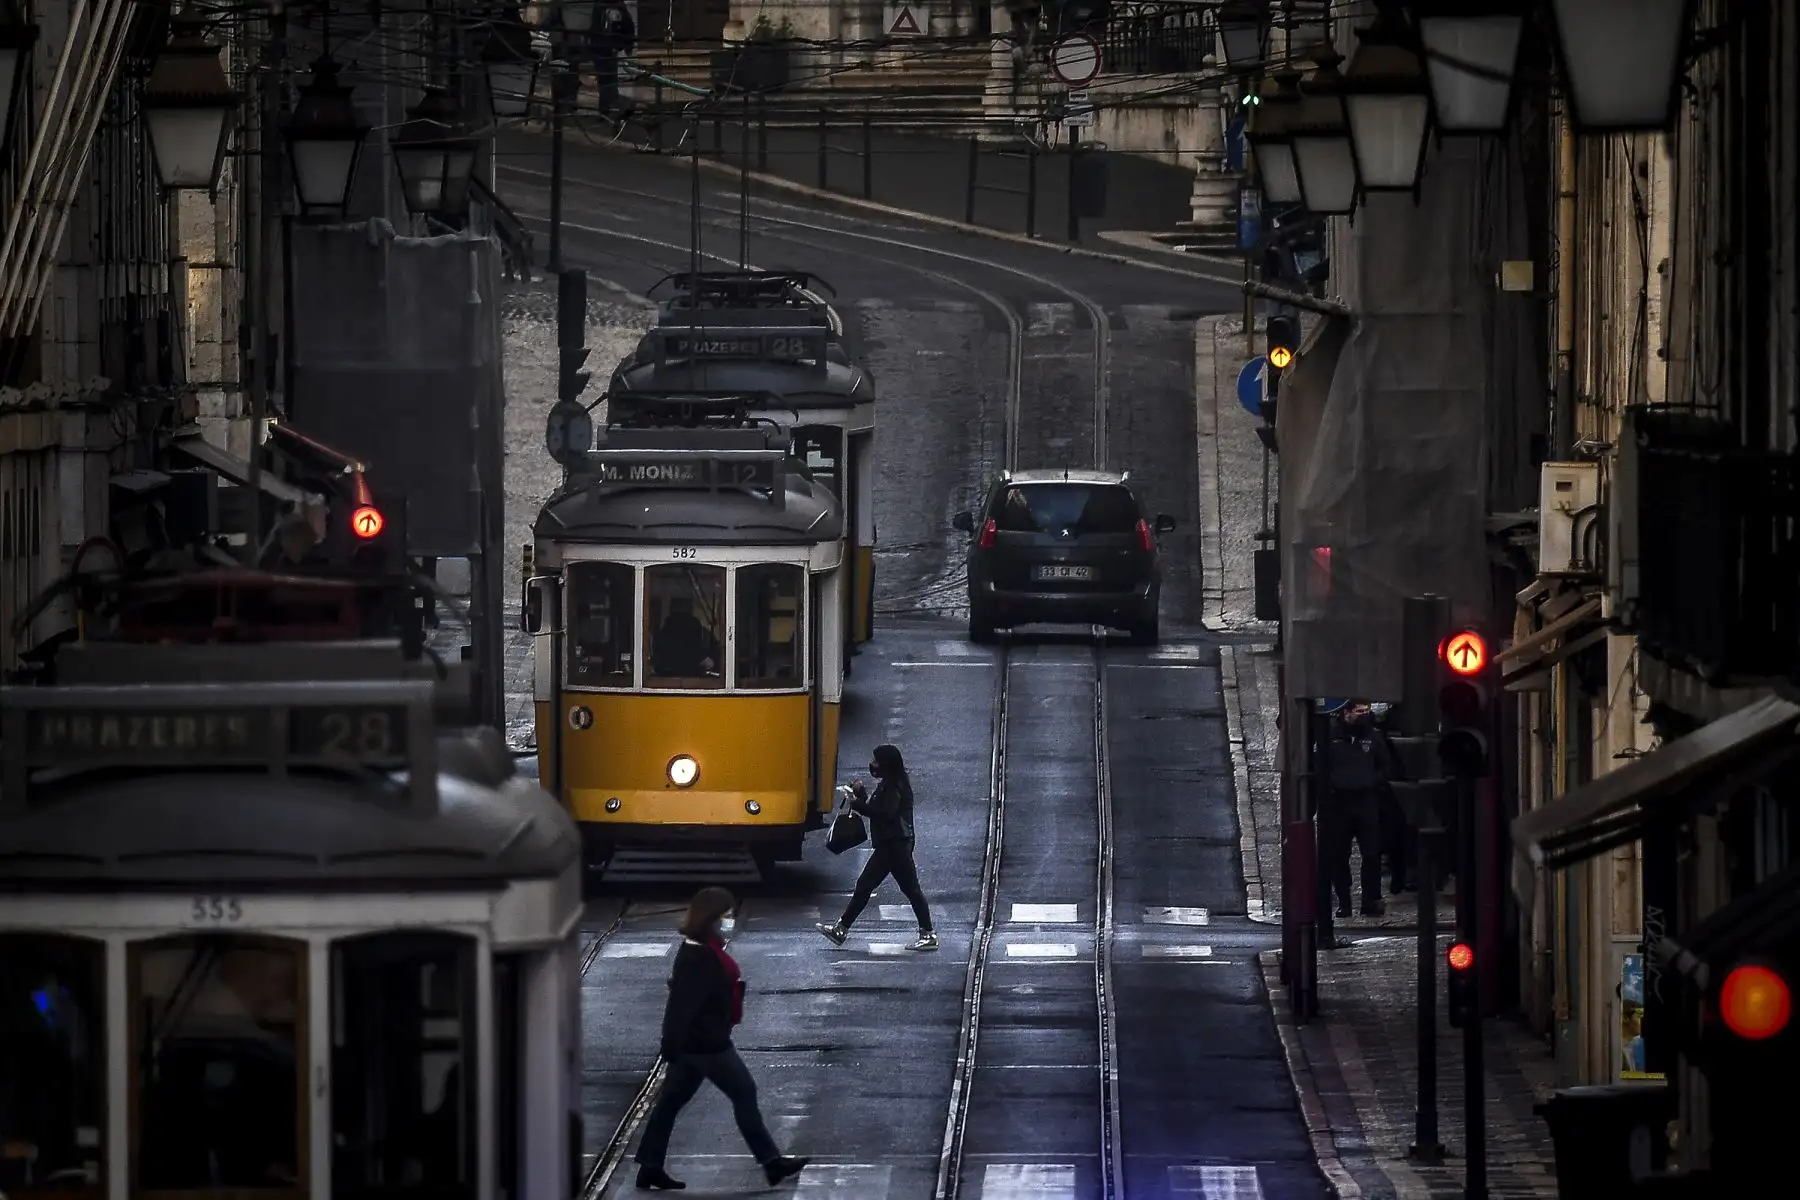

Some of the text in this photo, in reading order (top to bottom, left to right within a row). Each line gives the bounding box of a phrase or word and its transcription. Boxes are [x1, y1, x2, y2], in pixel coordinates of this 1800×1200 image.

[773, 338, 804, 356] 28
[602, 465, 623, 480] M.
[731, 464, 757, 485] 12
[672, 547, 697, 559] 582
[319, 712, 393, 757] 28
[192, 897, 243, 921] 555
